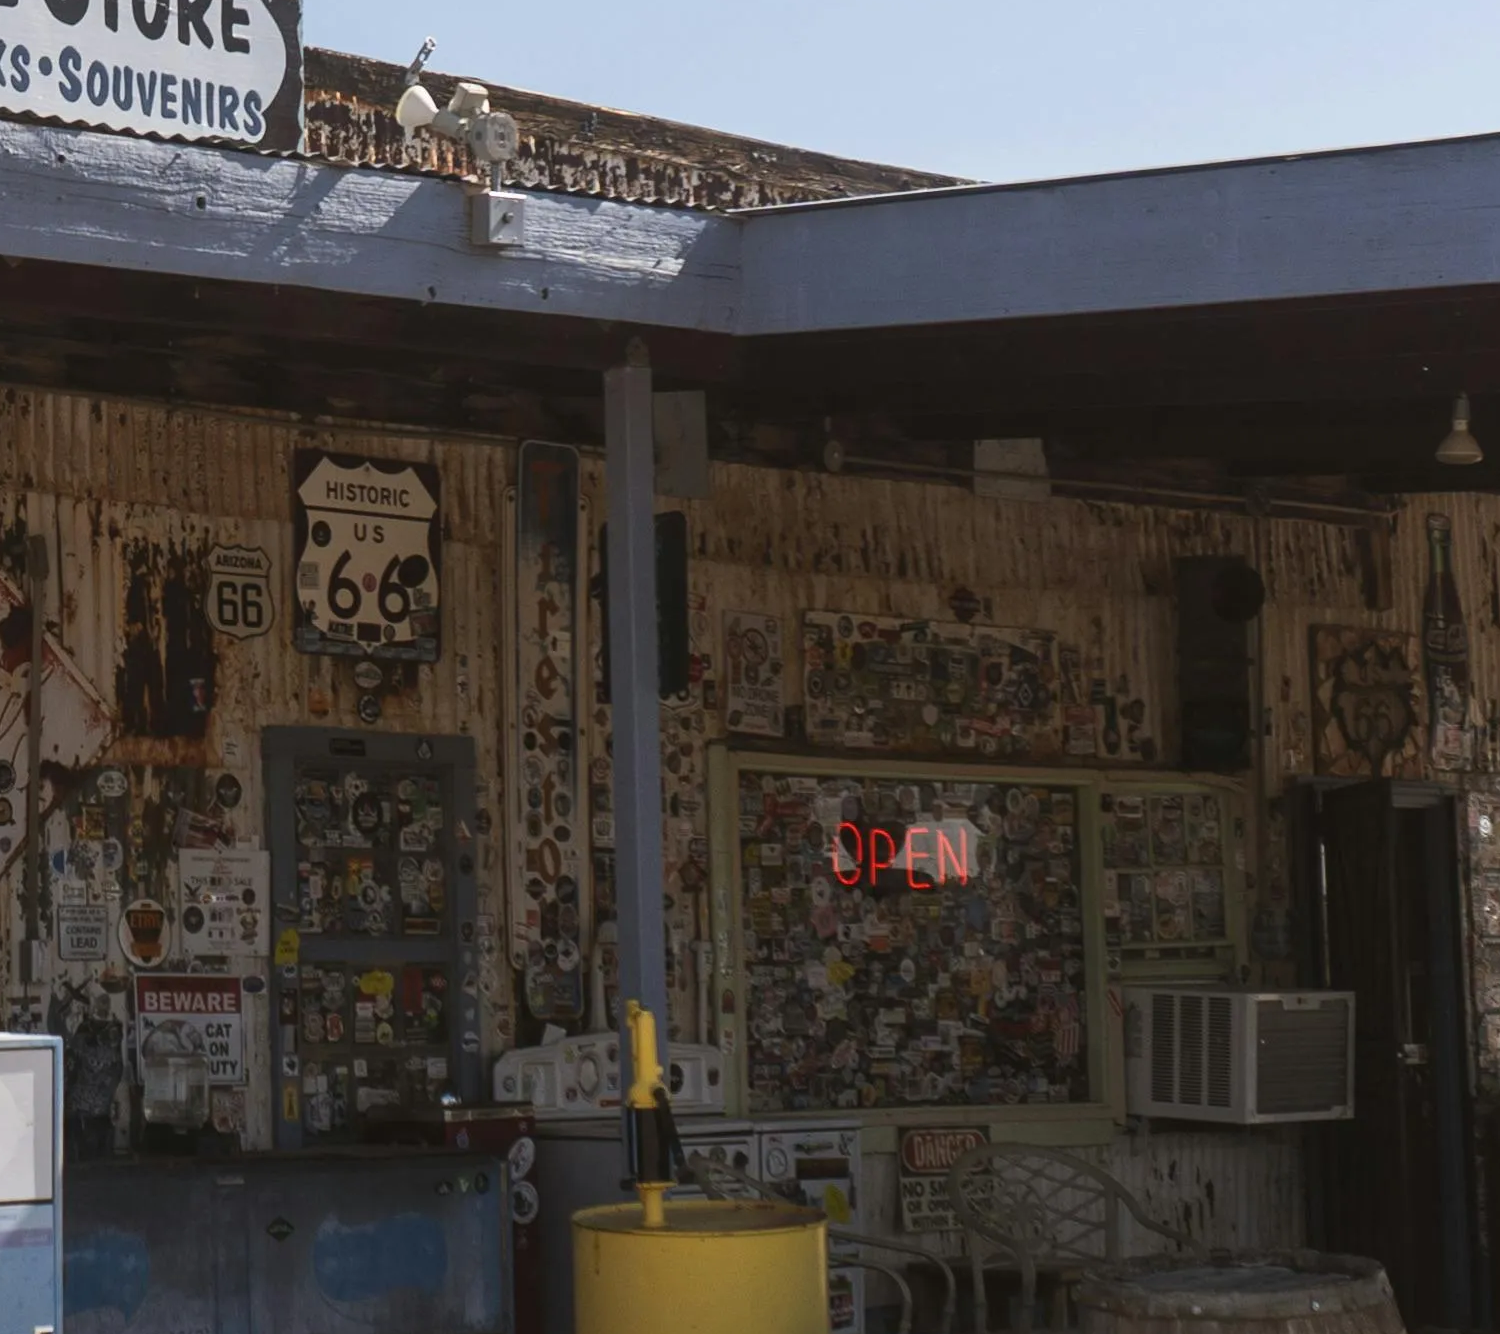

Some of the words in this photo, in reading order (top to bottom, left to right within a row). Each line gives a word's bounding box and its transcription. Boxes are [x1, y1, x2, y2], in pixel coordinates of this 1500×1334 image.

[59, 47, 264, 137] SOUVENIRS
[325, 480, 411, 509] HISTORIC
[353, 522, 385, 544] US
[214, 553, 263, 571] ARIZONA
[327, 549, 411, 624] 66
[217, 580, 263, 628] 66
[831, 819, 970, 891] OPEN
[65, 925, 102, 936] CONTAINS
[70, 937, 99, 949] LEAD
[143, 990, 237, 1012] BEWARE
[204, 1022, 233, 1039] CAT
[208, 1041, 230, 1056] ON
[208, 1060, 239, 1076] UTY
[901, 1181, 924, 1198] NO
